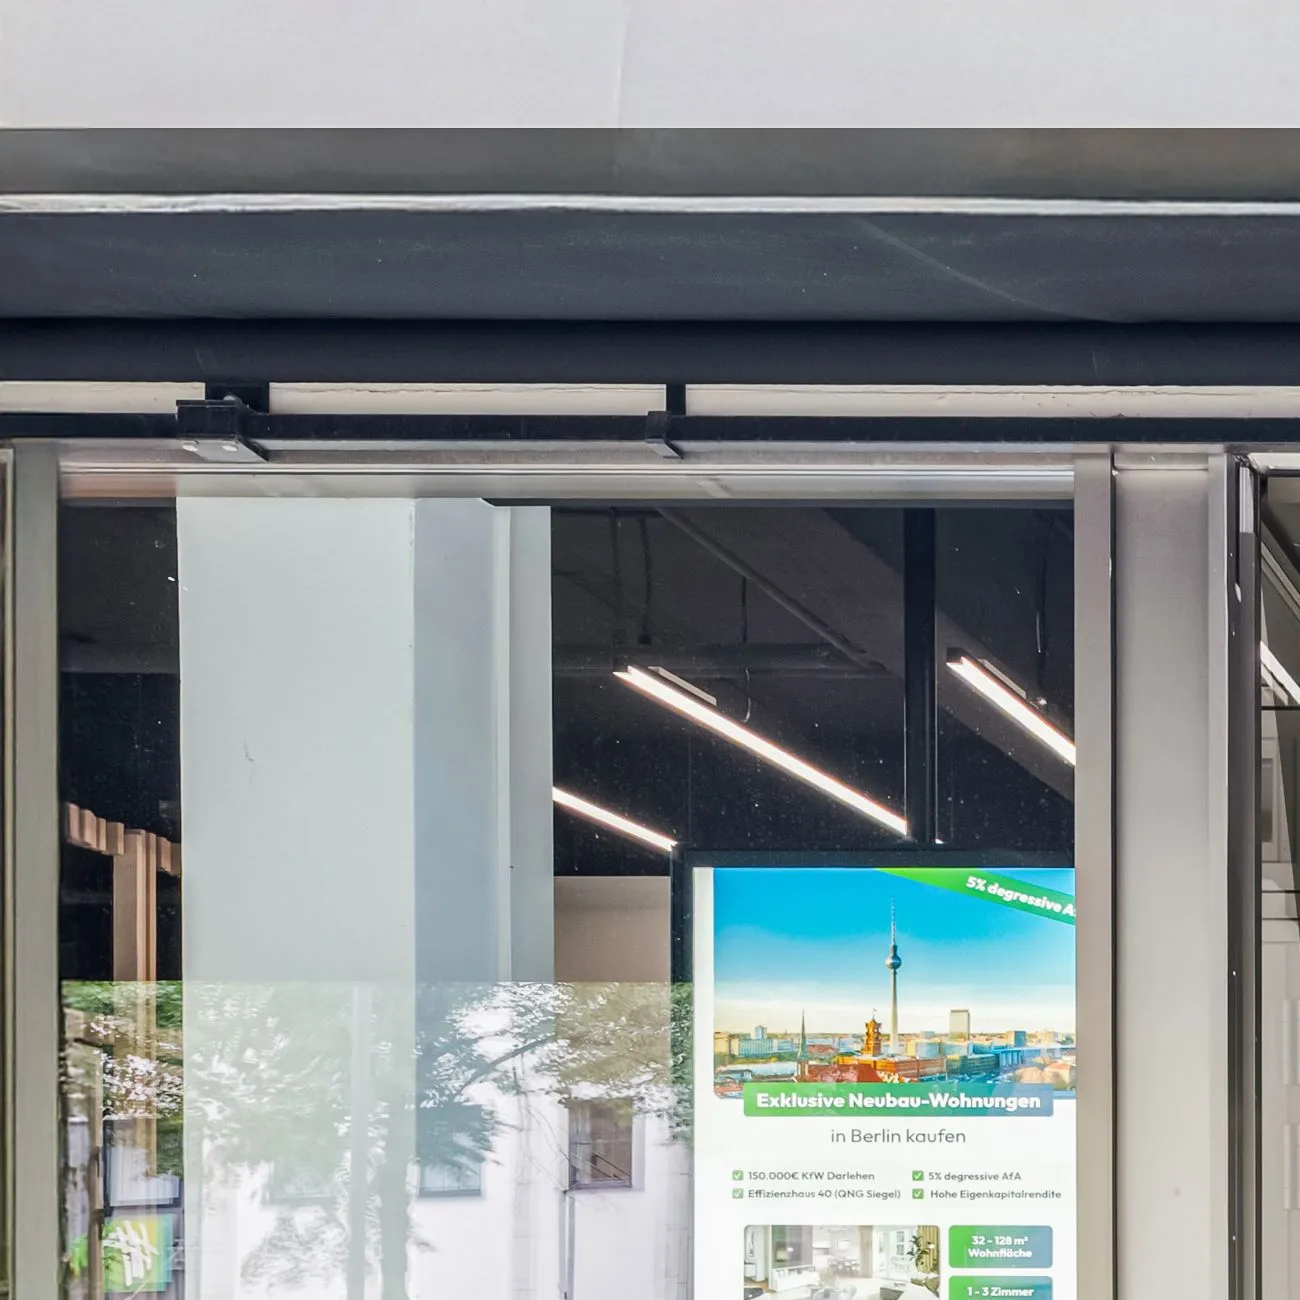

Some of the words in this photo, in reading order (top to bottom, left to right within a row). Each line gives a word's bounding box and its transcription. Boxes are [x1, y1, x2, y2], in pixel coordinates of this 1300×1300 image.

[966, 876, 988, 891] 5%
[987, 882, 1062, 913] degressive
[1062, 903, 1076, 917] A
[756, 1092, 845, 1108] Exklusive
[849, 1092, 1041, 1112] Neubau-Wohnungen
[831, 1129, 846, 1143] in
[851, 1128, 901, 1143] Berlin
[906, 1128, 966, 1143] kaufen
[748, 1171, 799, 1181] 150.000€
[801, 1171, 825, 1181] KfW
[827, 1171, 875, 1181] Darlehen
[928, 1172, 942, 1181] 5%
[944, 1171, 999, 1182] degressive
[1002, 1171, 1022, 1181] AfA
[748, 1189, 815, 1199] Effizienzhaus
[818, 1189, 832, 1199] 40
[834, 1189, 864, 1200] (QNG
[867, 1189, 901, 1201] Siegel)
[930, 1190, 957, 1199] Hohe
[960, 1189, 1062, 1200] Eigenkapitalrendite
[971, 1236, 986, 1245] 32
[994, 1236, 1013, 1246] 128
[968, 1248, 1033, 1258] Wohnfläche
[967, 1287, 973, 1296] 1
[982, 1287, 989, 1296] 3
[990, 1287, 1034, 1297] Zimmer
